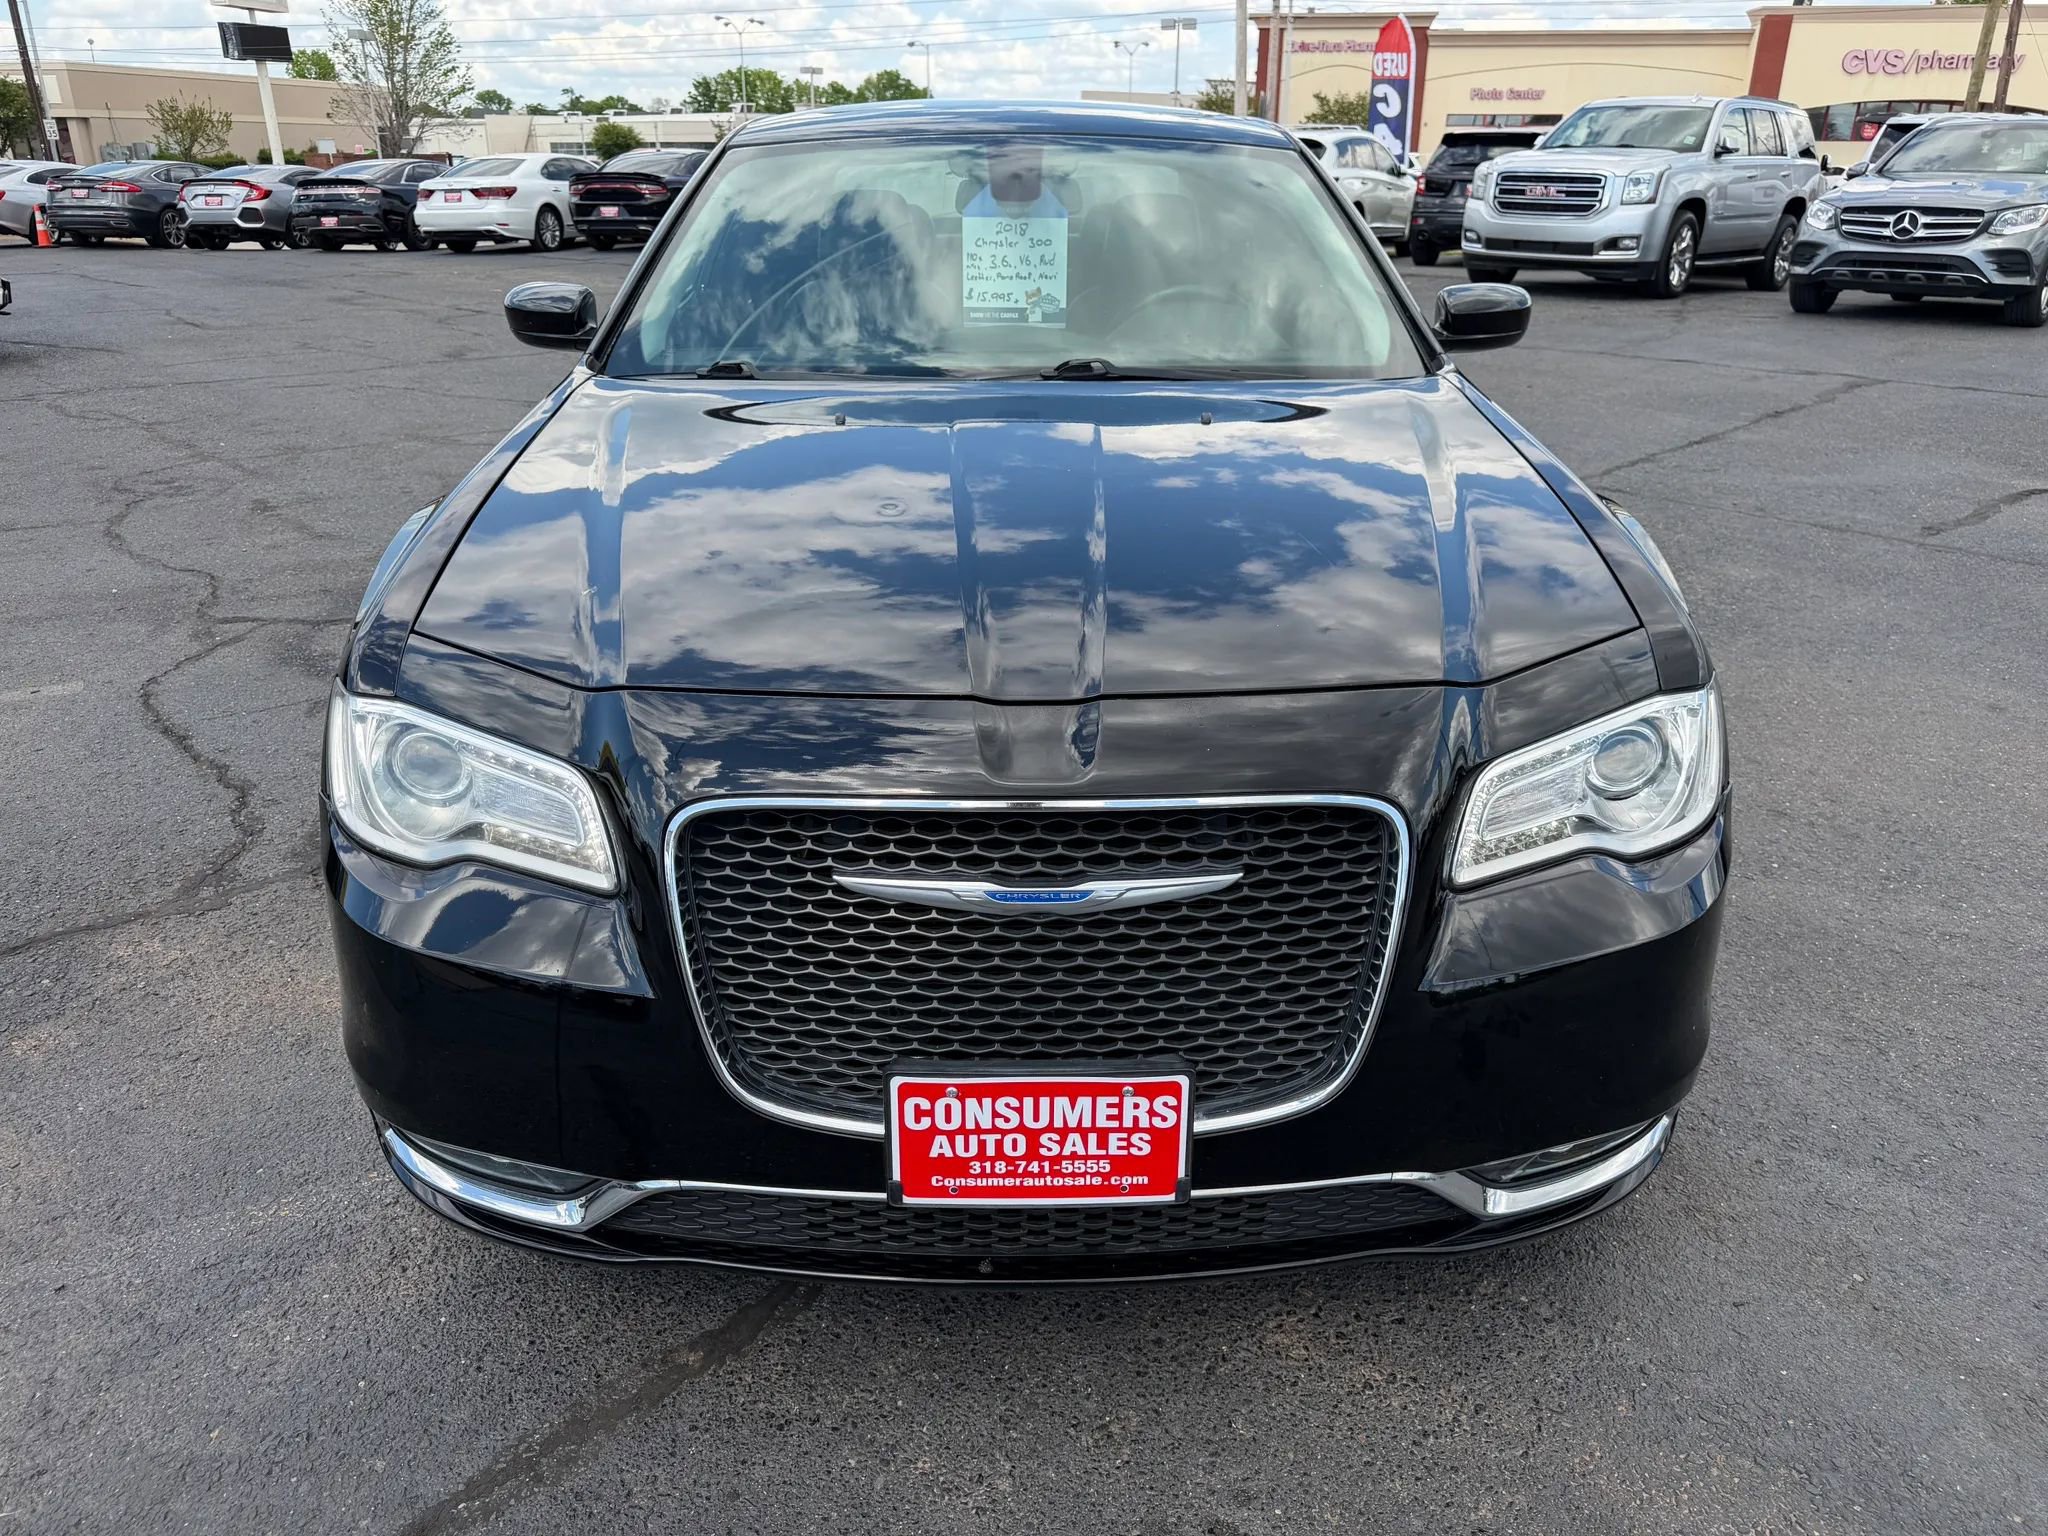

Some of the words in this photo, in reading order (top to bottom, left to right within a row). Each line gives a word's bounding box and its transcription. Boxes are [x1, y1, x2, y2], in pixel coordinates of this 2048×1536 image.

[1470, 87, 1504, 101] Photo
[1506, 87, 1546, 101] Center
[47, 129, 58, 138] 35
[1525, 185, 1567, 198] GMC
[995, 221, 1029, 236] 2018
[974, 236, 1019, 249] Chrysler
[1028, 238, 1053, 248] 300
[903, 1095, 1178, 1130] CONSUMERS
[928, 1133, 1027, 1158] AUTO
[1038, 1132, 1152, 1156] SALES
[968, 1159, 1111, 1175] 318-741-5555
[930, 1174, 1149, 1187] Consumerautosale.com
